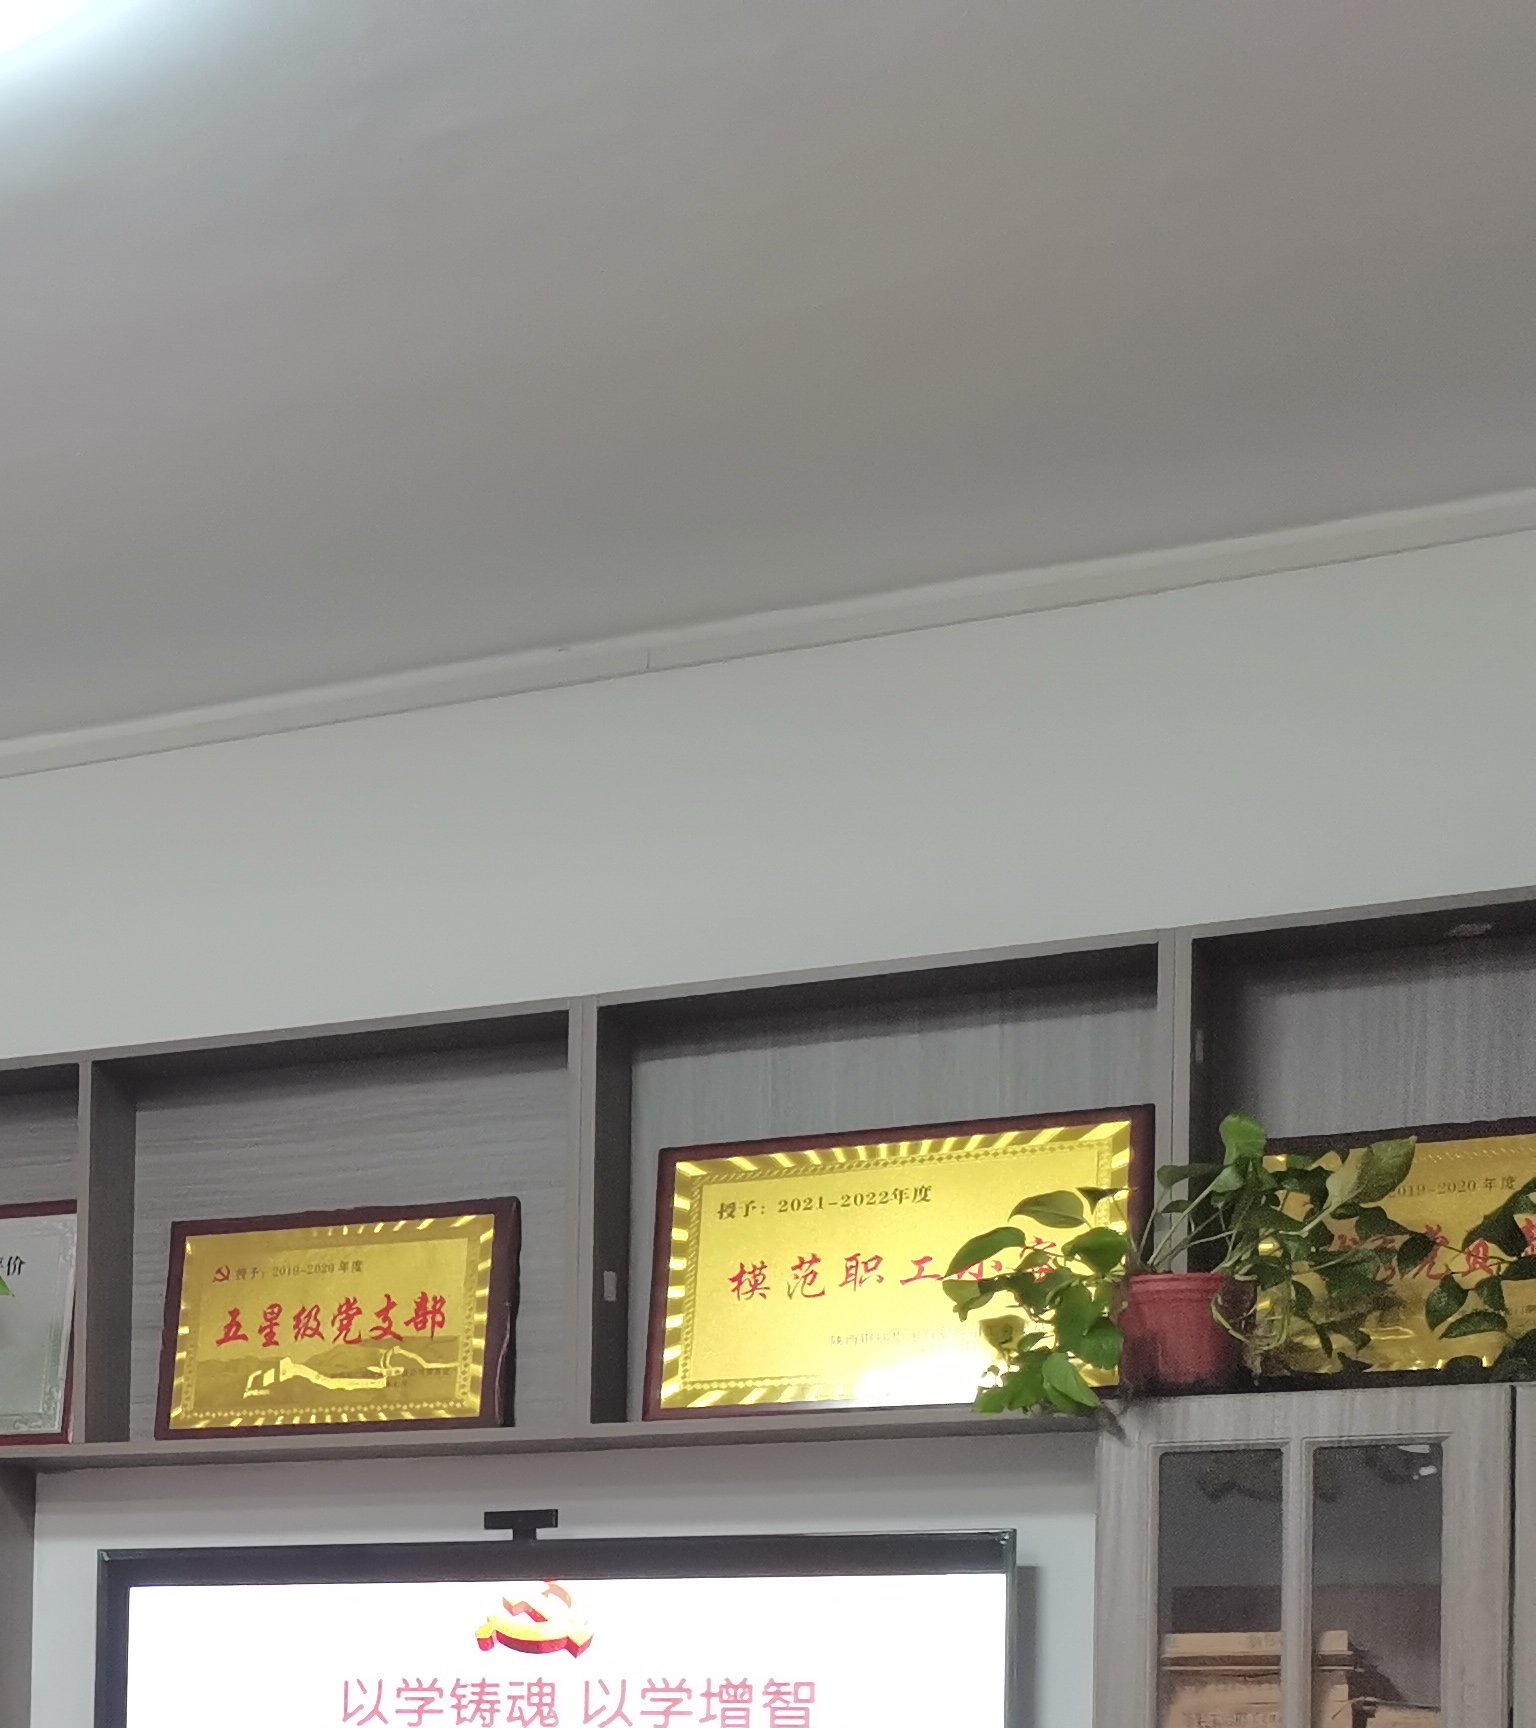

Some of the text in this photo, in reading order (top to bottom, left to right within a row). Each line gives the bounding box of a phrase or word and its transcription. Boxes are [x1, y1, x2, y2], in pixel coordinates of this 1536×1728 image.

[215, 1291, 447, 1348] 五星级党支部
